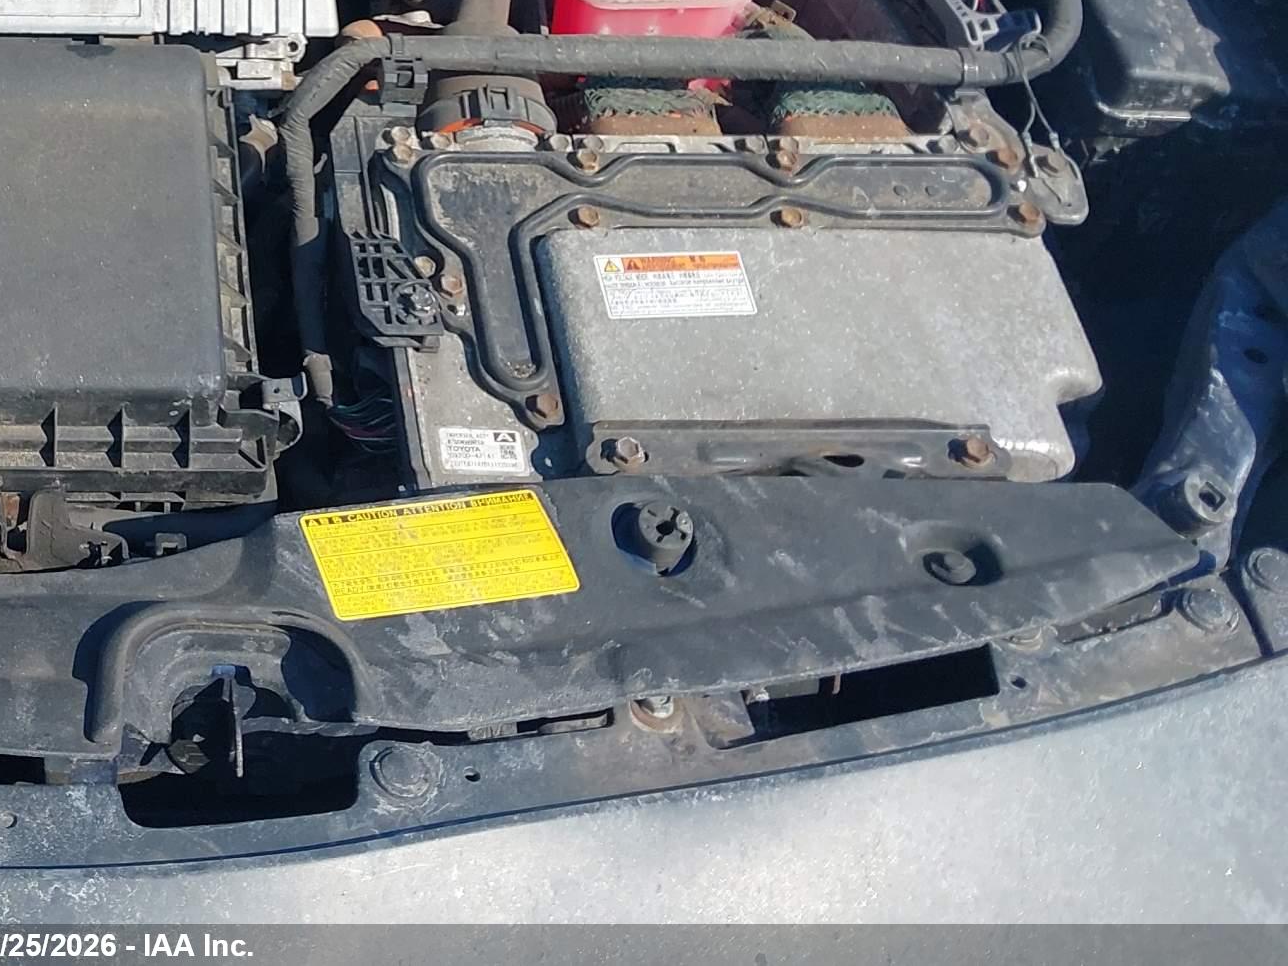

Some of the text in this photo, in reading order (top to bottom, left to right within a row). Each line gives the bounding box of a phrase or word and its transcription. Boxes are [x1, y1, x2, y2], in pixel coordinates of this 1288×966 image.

[447, 445, 481, 453] TOYOTA
[347, 509, 398, 523] CAUTION
[402, 501, 465, 516] ATTENTION
[470, 493, 530, 508] ВНИМАНИЕ
